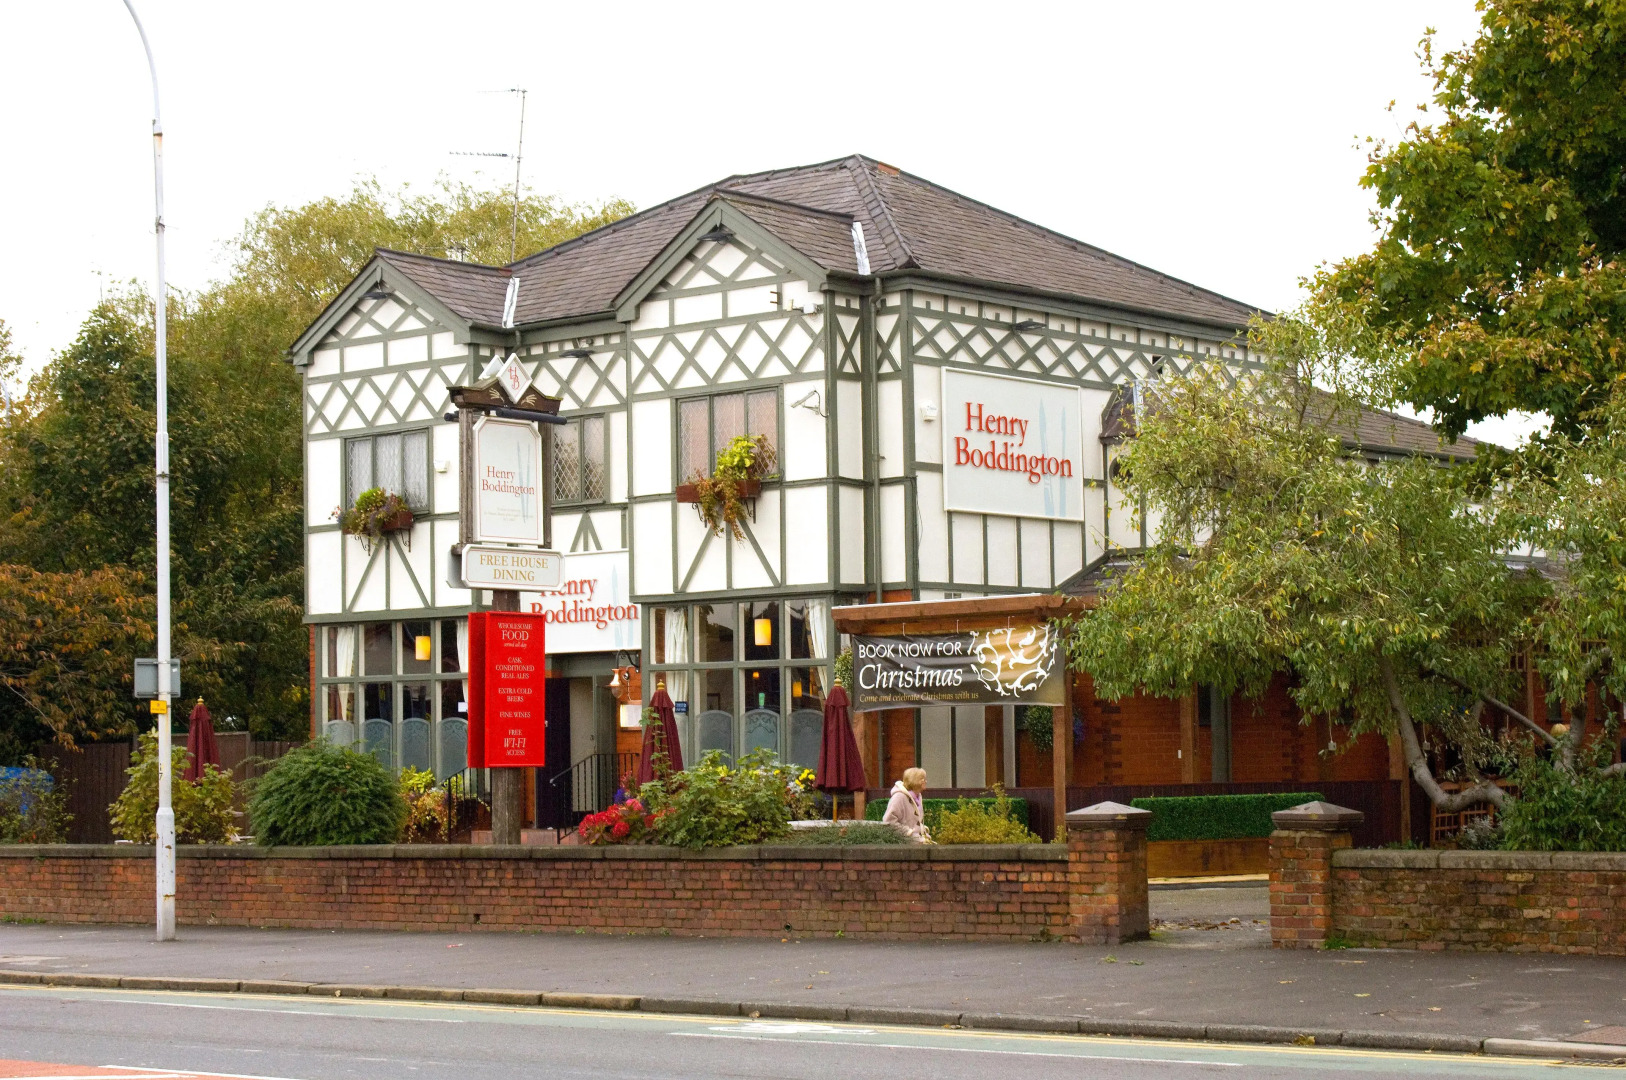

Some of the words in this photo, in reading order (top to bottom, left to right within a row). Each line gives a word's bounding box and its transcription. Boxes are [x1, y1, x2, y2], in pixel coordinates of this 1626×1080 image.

[965, 402, 1029, 447] Henry
[954, 436, 1073, 484] Boddington
[487, 465, 515, 483] Henry
[482, 479, 535, 497] Boddington
[480, 554, 508, 566] FREE
[511, 556, 549, 569] HOUSE
[493, 568, 535, 581] DINING
[540, 578, 597, 602] enry
[498, 622, 532, 630] WHOLESOME
[502, 629, 529, 641] FOOD
[859, 644, 895, 659] BOOK
[898, 642, 934, 657] NOW
[936, 641, 963, 656] FOR
[508, 656, 522, 664] CASK
[516, 672, 530, 680] ALES
[859, 663, 963, 690] Christmas
[516, 687, 533, 695] COLD
[859, 693, 879, 703] Come
[879, 693, 891, 702] and
[892, 693, 920, 702] celebrate
[920, 691, 954, 700] Christmas
[954, 690, 970, 699] with
[504, 737, 527, 748] WI-FI
